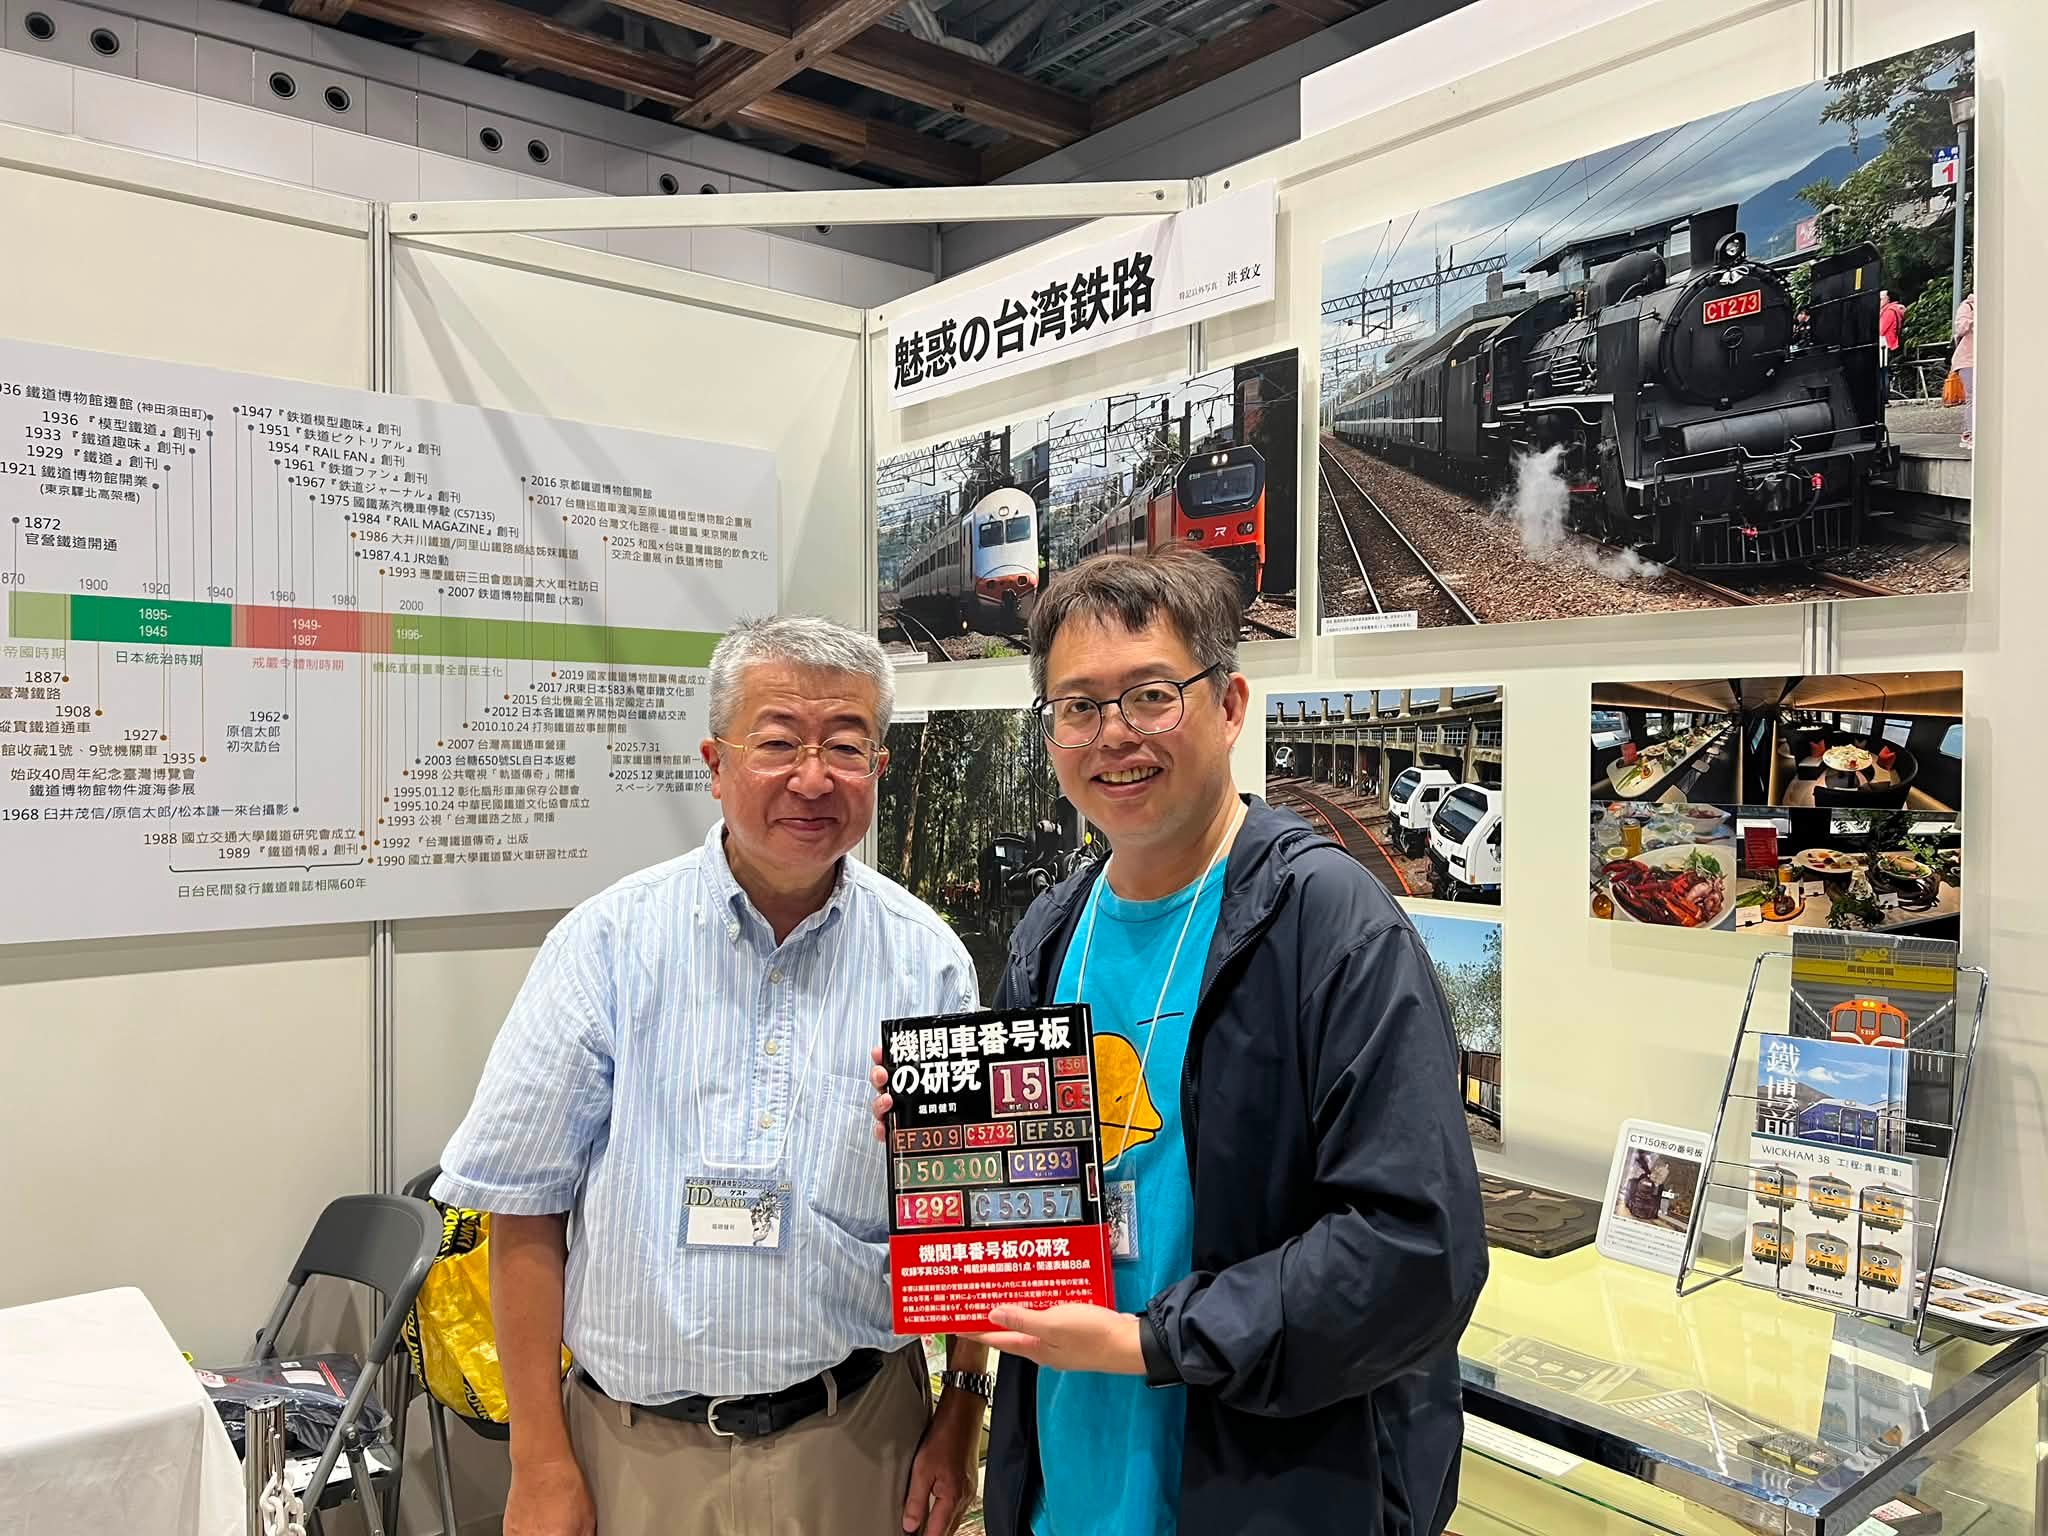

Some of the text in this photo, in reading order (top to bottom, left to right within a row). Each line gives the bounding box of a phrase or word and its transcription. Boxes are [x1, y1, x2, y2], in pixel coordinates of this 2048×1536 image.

[1942, 163, 1954, 182] 1
[1707, 294, 1758, 319] CT273
[894, 252, 1156, 390] 魅惑の台湾鉄路
[0, 383, 21, 396] 36
[137, 401, 208, 421] (神田須田町)
[240, 405, 272, 418] 1947
[42, 411, 79, 426] 1936
[25, 426, 61, 440] 1933
[259, 423, 290, 437] 1951
[27, 445, 63, 459] 1929
[268, 441, 299, 454] 1954
[284, 458, 315, 472] 1961
[1, 462, 149, 488] 1921 鐵道博物館開業
[531, 475, 557, 488] 2016
[295, 475, 326, 489] 1967
[320, 494, 350, 507] 1975
[537, 495, 562, 506] 2017
[24, 516, 61, 531] 1872
[352, 512, 381, 525] 1984
[571, 514, 596, 526] 2020
[25, 533, 118, 551] 官營鐵道開通
[359, 531, 388, 543] 1986
[611, 536, 635, 547] 2025
[362, 549, 449, 567] 1987.4.1 JR始動
[665, 555, 674, 564] in
[389, 567, 416, 578] 1993
[79, 578, 108, 591] 1900
[142, 582, 170, 595] 1920
[207, 586, 234, 598] 1940
[270, 590, 296, 602] 1960
[448, 586, 475, 598] 2007
[332, 594, 357, 606] 1980
[400, 599, 424, 611] 2000
[138, 608, 172, 621] 1895-
[138, 625, 168, 638] 1945
[292, 619, 322, 631] 1949-
[292, 634, 317, 646] 1987
[116, 651, 202, 666] 日本統治時期
[25, 671, 61, 683] 1887
[559, 670, 584, 680] 2019
[537, 682, 562, 693] 2017
[512, 694, 537, 705] 2015
[56, 706, 91, 717] 1908
[249, 711, 281, 722] 1962
[492, 707, 518, 717] 2012
[226, 725, 280, 738] 原信太郎
[471, 722, 529, 732] 2010.10.24
[124, 729, 157, 741] 1927
[226, 740, 280, 753] 初次訪台
[447, 739, 474, 750] 2007
[615, 742, 660, 752] 2025.7.31
[163, 753, 195, 764] 1935
[424, 755, 452, 765] 2003
[411, 769, 438, 780] 1998
[615, 770, 652, 780] 2025.12
[30, 783, 195, 797] 鐵道博物館物件渡海參展
[394, 787, 454, 797] 1995.01.12
[394, 801, 454, 811] 1995.10.24
[3, 808, 38, 821] 1968
[387, 815, 415, 826] 1993
[144, 829, 356, 845] 1988 國立交通大學鐵道研究會成立
[382, 838, 410, 848] 1992
[218, 848, 250, 859] 1989
[377, 855, 405, 866] 1990
[889, 1017, 1071, 1063] 機関車番号板
[892, 1058, 982, 1095] の研究
[1001, 1067, 1043, 1104] 15
[967, 1125, 1015, 1140] C5732
[1026, 1121, 1075, 1140] EF 58
[896, 1129, 959, 1149] EF 30 9
[1762, 1144, 1814, 1163] WICKHAM
[1818, 1154, 1831, 1164] 38
[1013, 1151, 1073, 1171] C1293
[917, 1159, 945, 1182] 50
[953, 1157, 998, 1180] 300
[685, 1187, 746, 1208] ID CARD
[903, 1196, 959, 1220] 1292
[975, 1190, 1074, 1220] C 53 57
[919, 1238, 1070, 1263] 機関車番号板の研究
